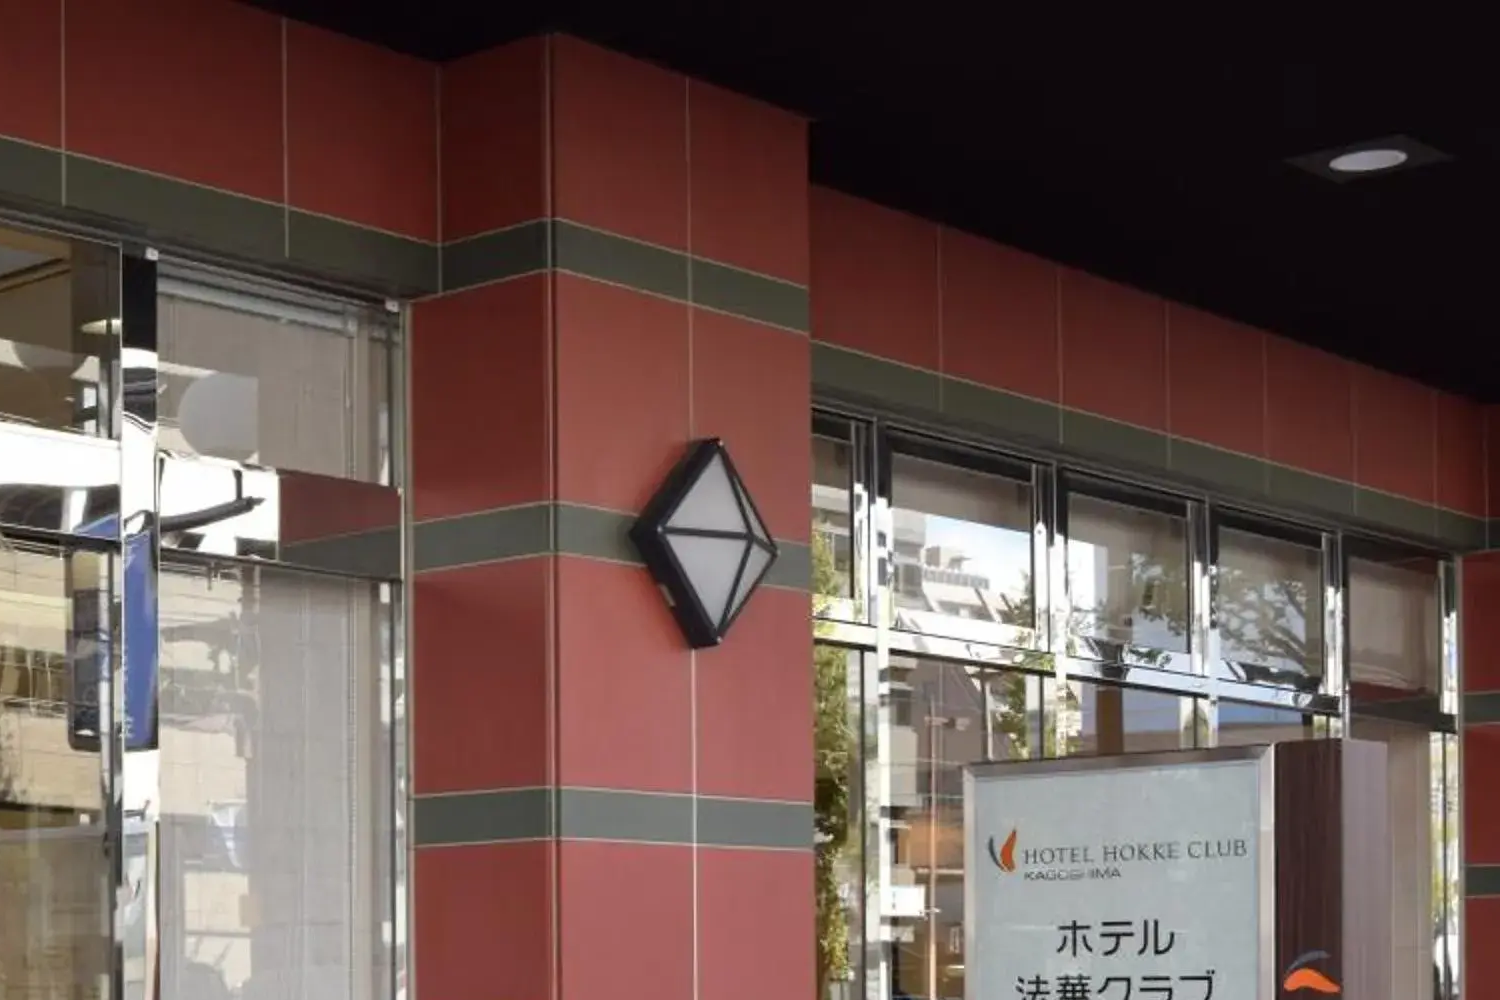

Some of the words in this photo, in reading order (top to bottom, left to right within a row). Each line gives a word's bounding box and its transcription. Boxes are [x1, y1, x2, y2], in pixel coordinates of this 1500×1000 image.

[1023, 847, 1095, 865] HOTEL
[1102, 842, 1180, 862] HOKKE
[1187, 838, 1248, 859] CLUB
[1056, 919, 1175, 957] ホテル
